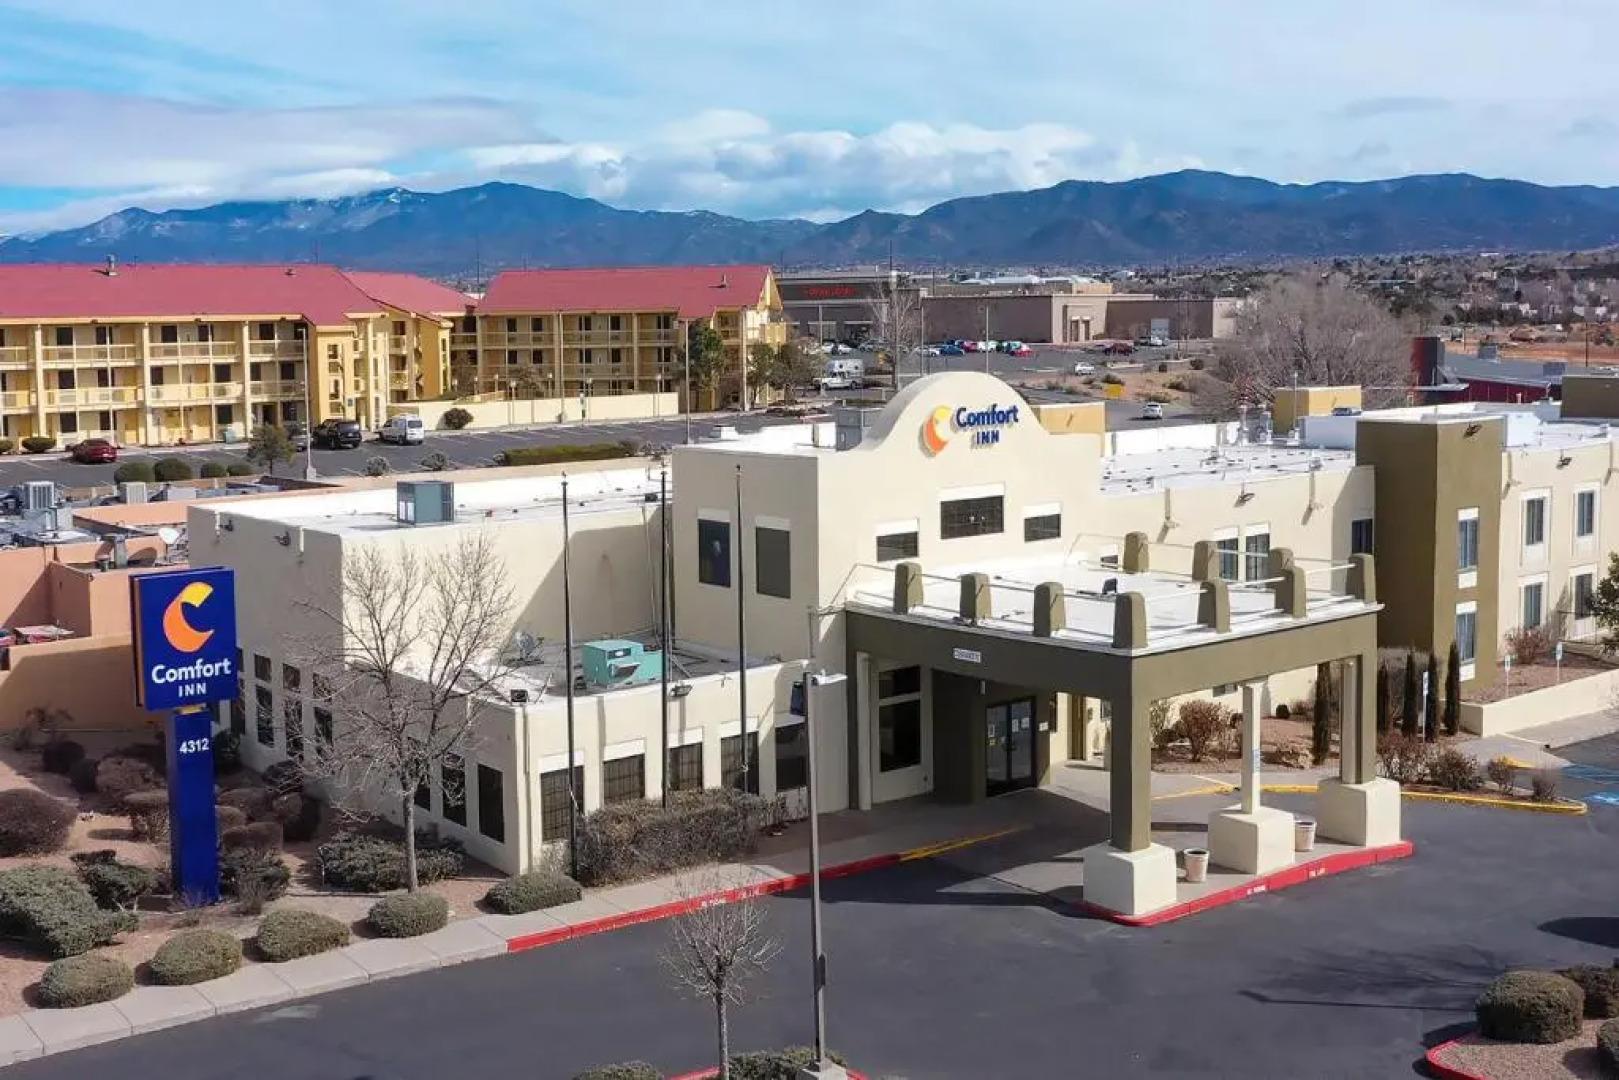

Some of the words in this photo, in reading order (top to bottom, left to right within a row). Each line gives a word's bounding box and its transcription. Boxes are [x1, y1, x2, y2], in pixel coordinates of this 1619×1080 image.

[956, 403, 1019, 428] Comfort
[976, 430, 999, 444] INN
[151, 658, 231, 684] Comfort
[178, 682, 207, 698] INN
[179, 738, 210, 754] 4312
